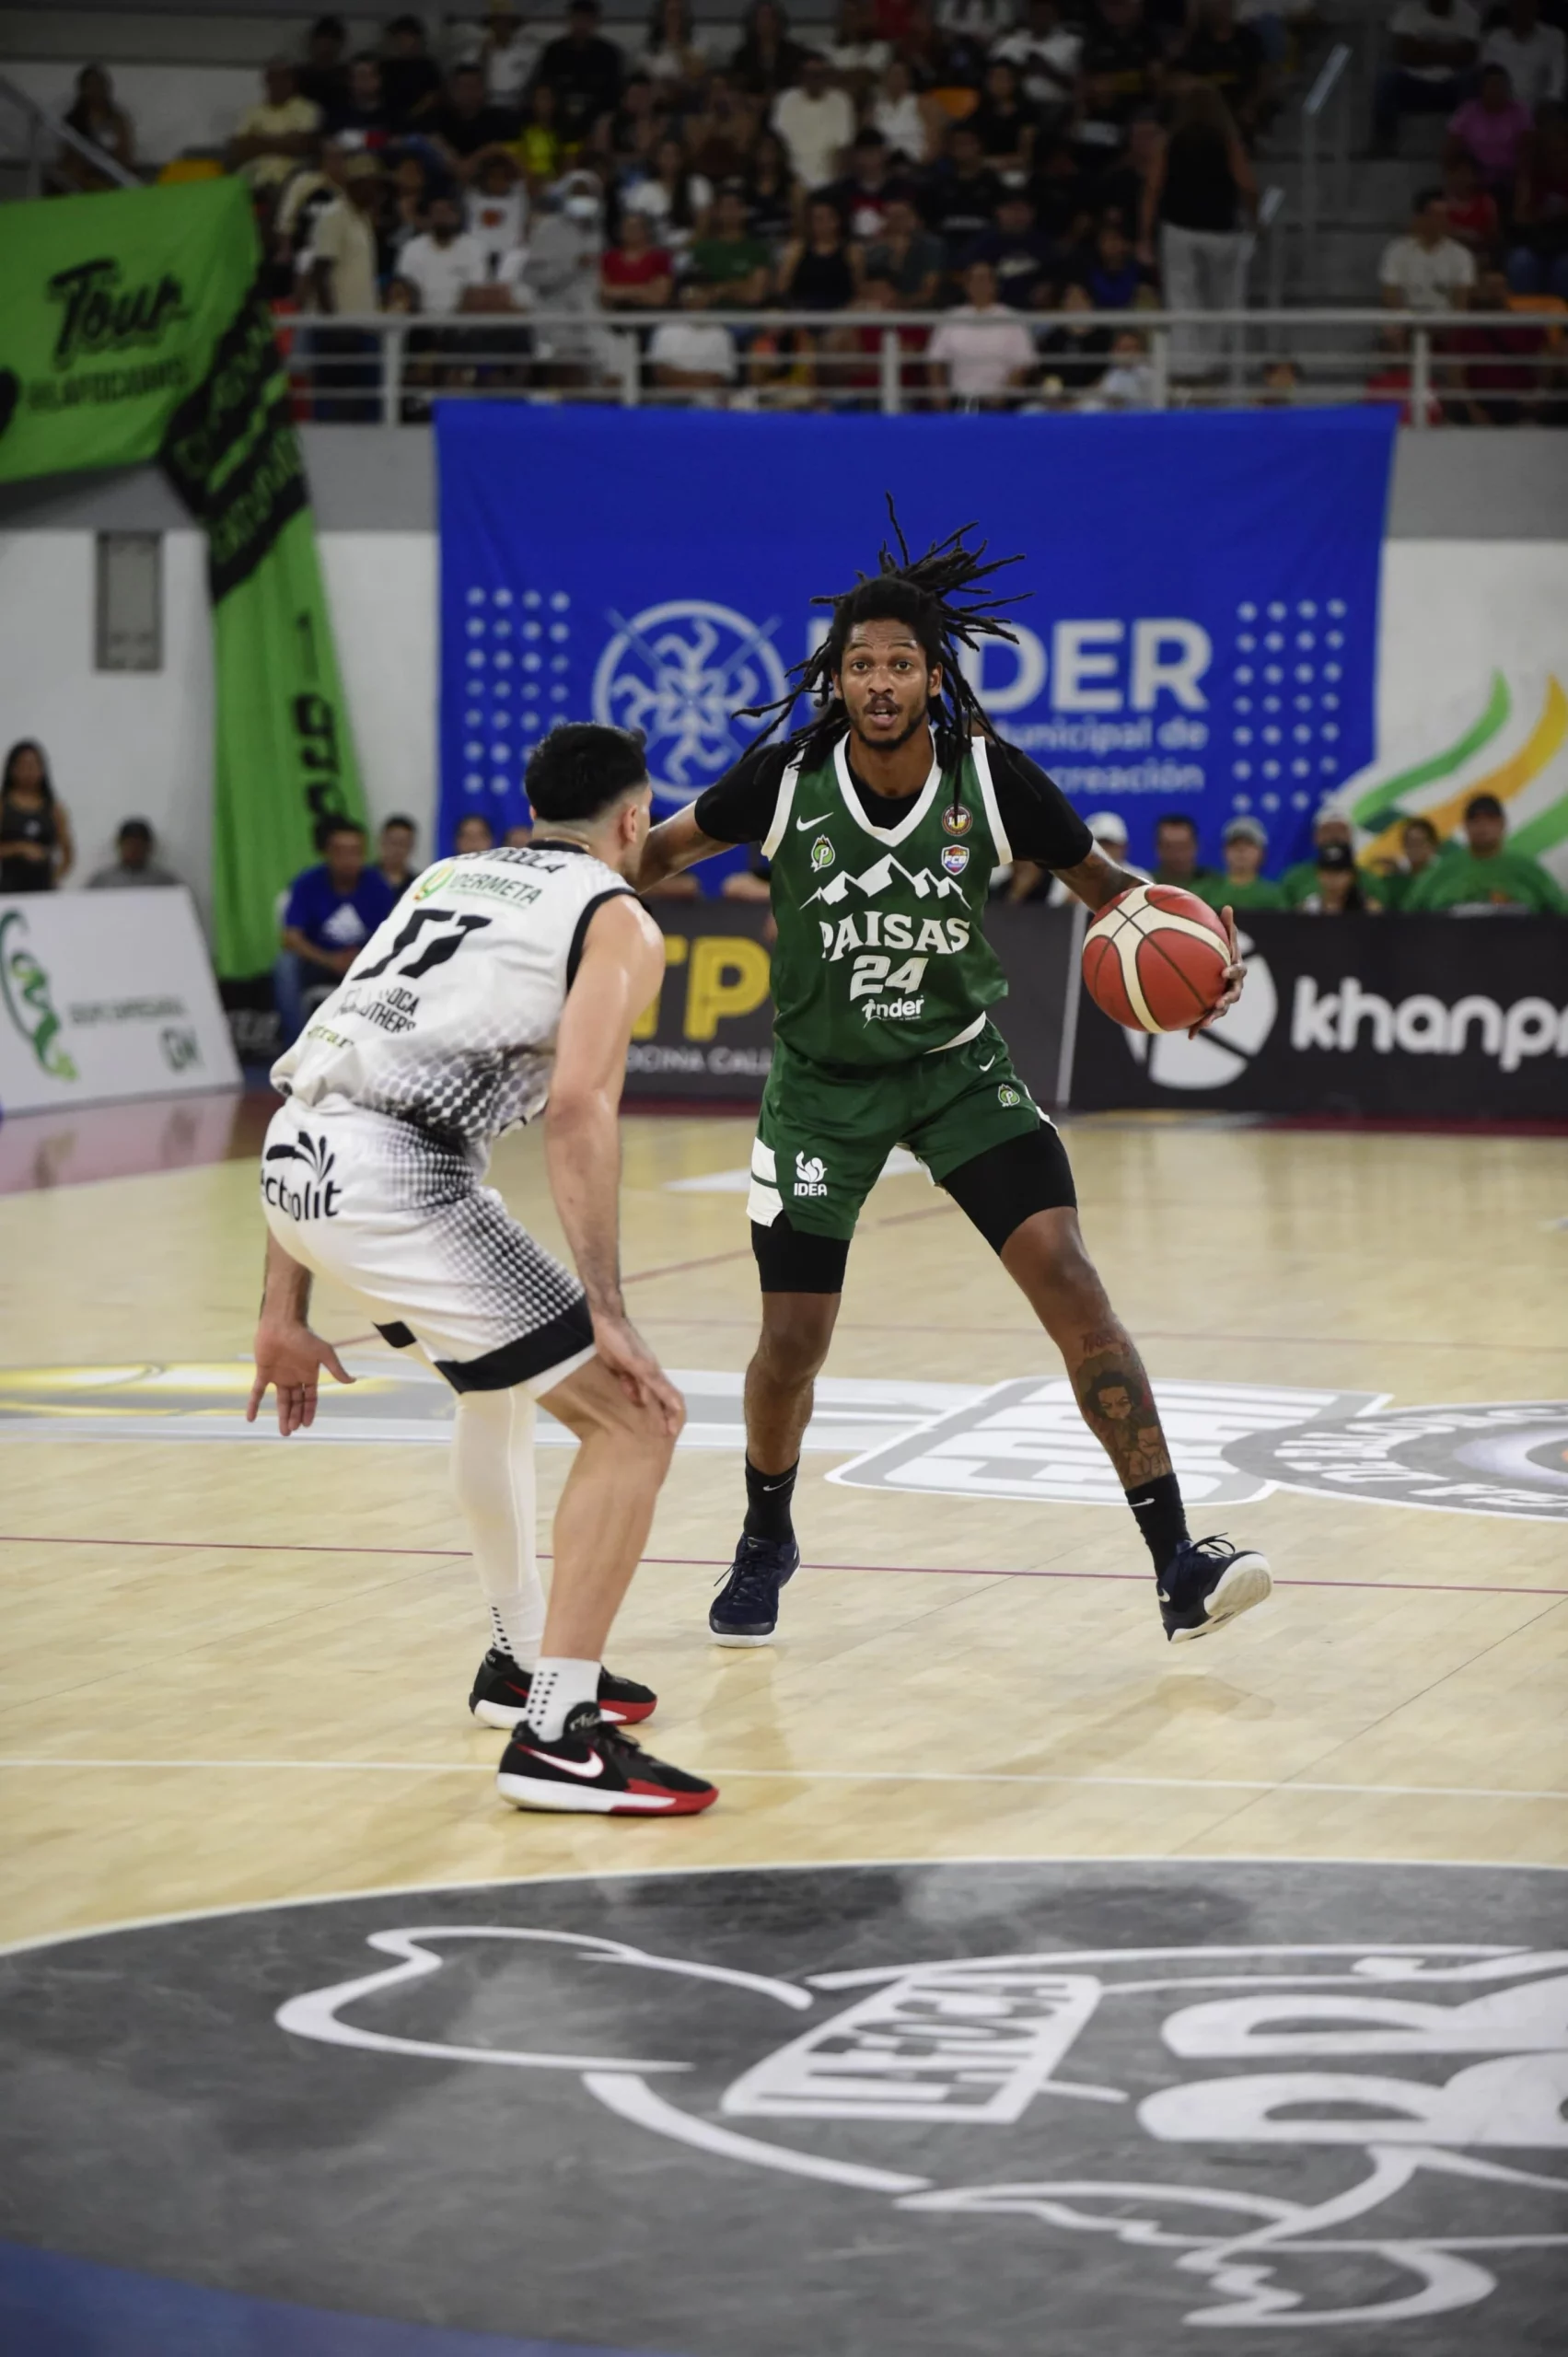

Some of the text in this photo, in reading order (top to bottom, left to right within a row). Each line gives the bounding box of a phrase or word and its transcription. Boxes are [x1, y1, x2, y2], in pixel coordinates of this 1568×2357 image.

[46, 256, 191, 372] Tour
[807, 618, 1214, 713] IDER
[1048, 757, 1206, 795] creación
[850, 955, 929, 1002] 24
[794, 1182, 828, 1196] IDEA
